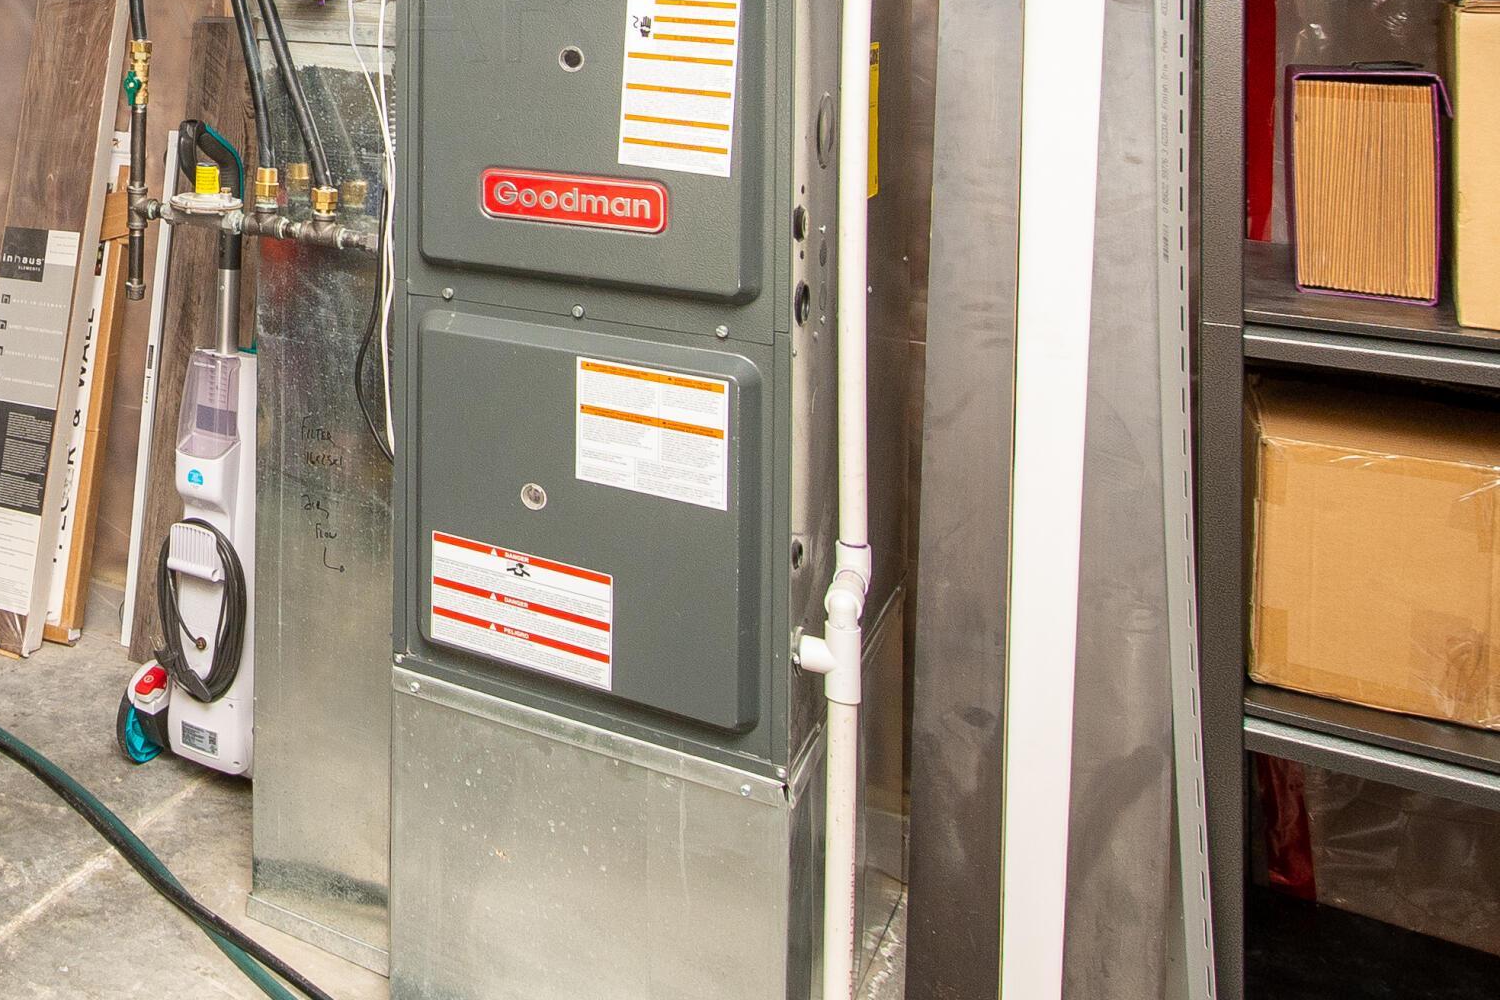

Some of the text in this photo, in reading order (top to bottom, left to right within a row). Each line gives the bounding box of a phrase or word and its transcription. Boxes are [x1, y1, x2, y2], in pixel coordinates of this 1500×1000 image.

[493, 181, 651, 220] Goodman
[504, 551, 530, 563] DANGER
[503, 596, 529, 609] DANGER
